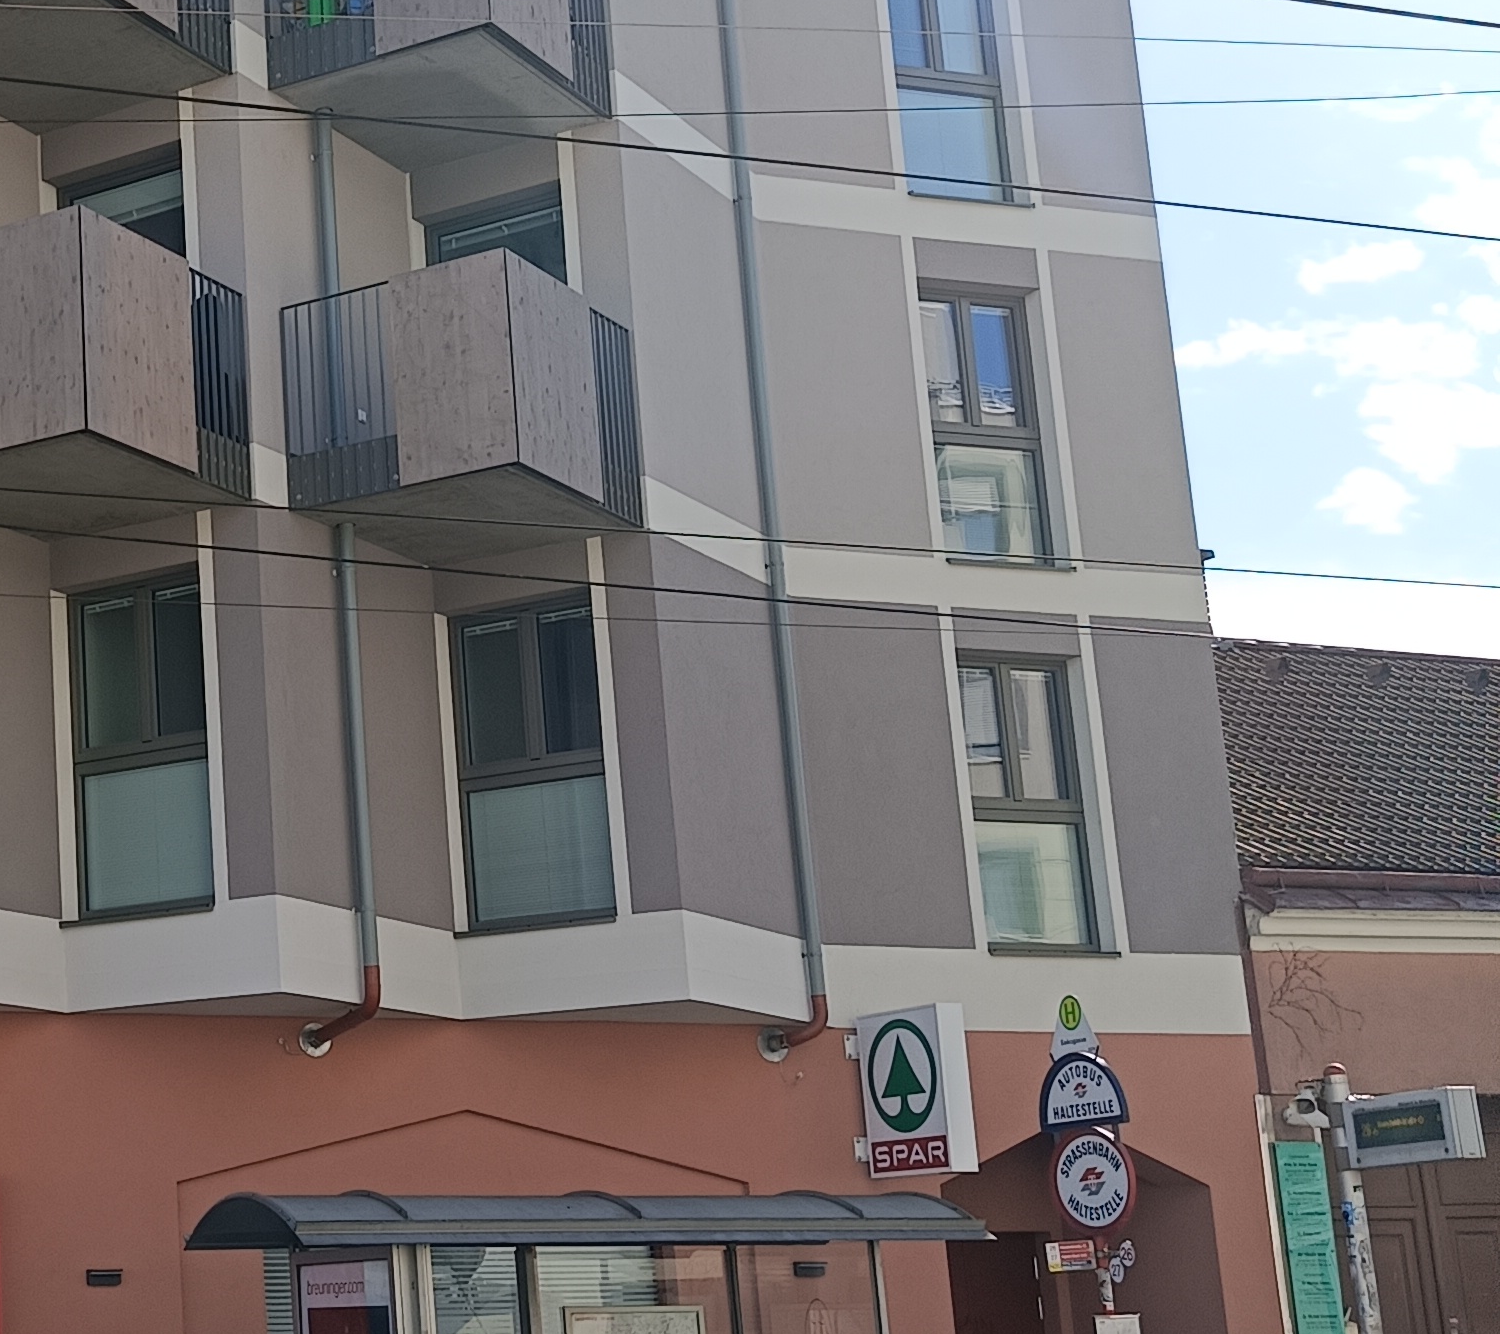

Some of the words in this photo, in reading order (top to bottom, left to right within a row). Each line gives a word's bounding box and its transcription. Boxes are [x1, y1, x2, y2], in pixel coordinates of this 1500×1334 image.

[1064, 1001, 1076, 1024] H
[1057, 1064, 1103, 1091] AUTOBUS
[1053, 1099, 1115, 1120] HALTESTELLE
[875, 1140, 946, 1168] SPAR
[1060, 1140, 1122, 1179] STRASSENBAHN
[1067, 1188, 1124, 1221] HALTESTELLE
[1120, 1247, 1133, 1262] 26
[1111, 1264, 1121, 1277] 27
